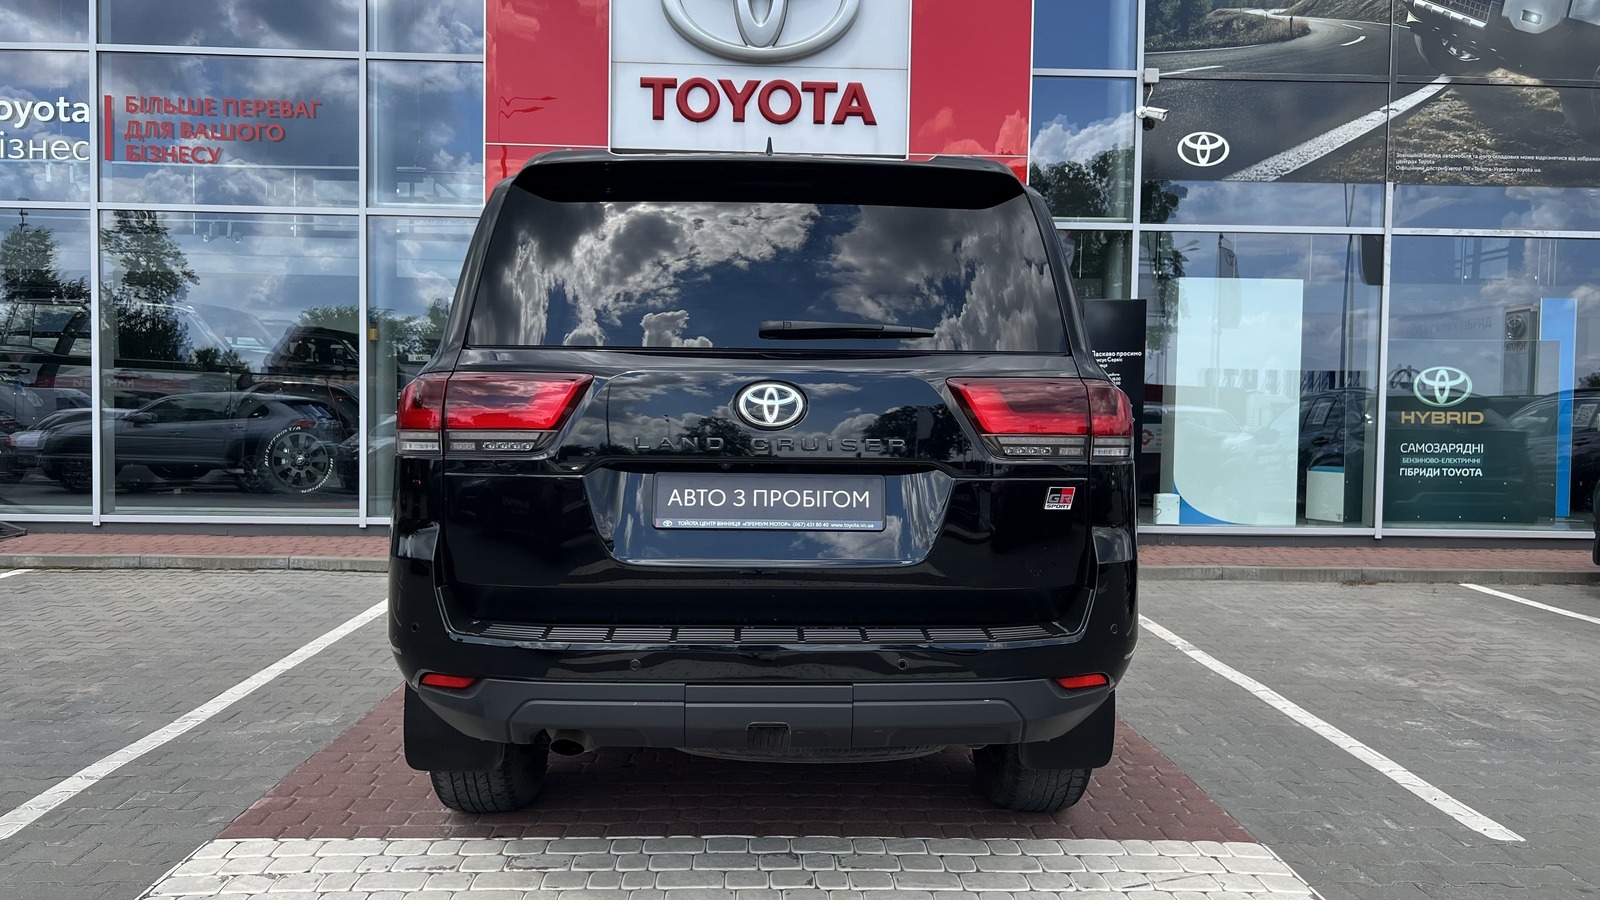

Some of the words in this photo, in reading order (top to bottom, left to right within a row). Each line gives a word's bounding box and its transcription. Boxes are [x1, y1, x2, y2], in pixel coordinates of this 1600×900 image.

[125, 96, 218, 116] БІЛЬШЕ
[222, 98, 322, 119] ПЕРЕВАГ
[640, 77, 878, 126] TOYOTA
[124, 120, 175, 141] ДЛЯ
[180, 121, 286, 142] ВАШОГО
[125, 144, 223, 164] БІЗНЕСУ
[1400, 411, 1485, 425] HYBRID
[634, 436, 725, 450] LAND
[750, 437, 906, 451] CRUISER
[1400, 443, 1484, 455] САМОЗАРЯДНІ
[1399, 468, 1440, 477] ГІБРИДИ
[1442, 468, 1483, 477] TOYOTA
[667, 489, 726, 507] АВТО
[733, 489, 746, 507] З
[753, 490, 870, 508] ПРОБІГОМ
[1048, 494, 1072, 504] GR
